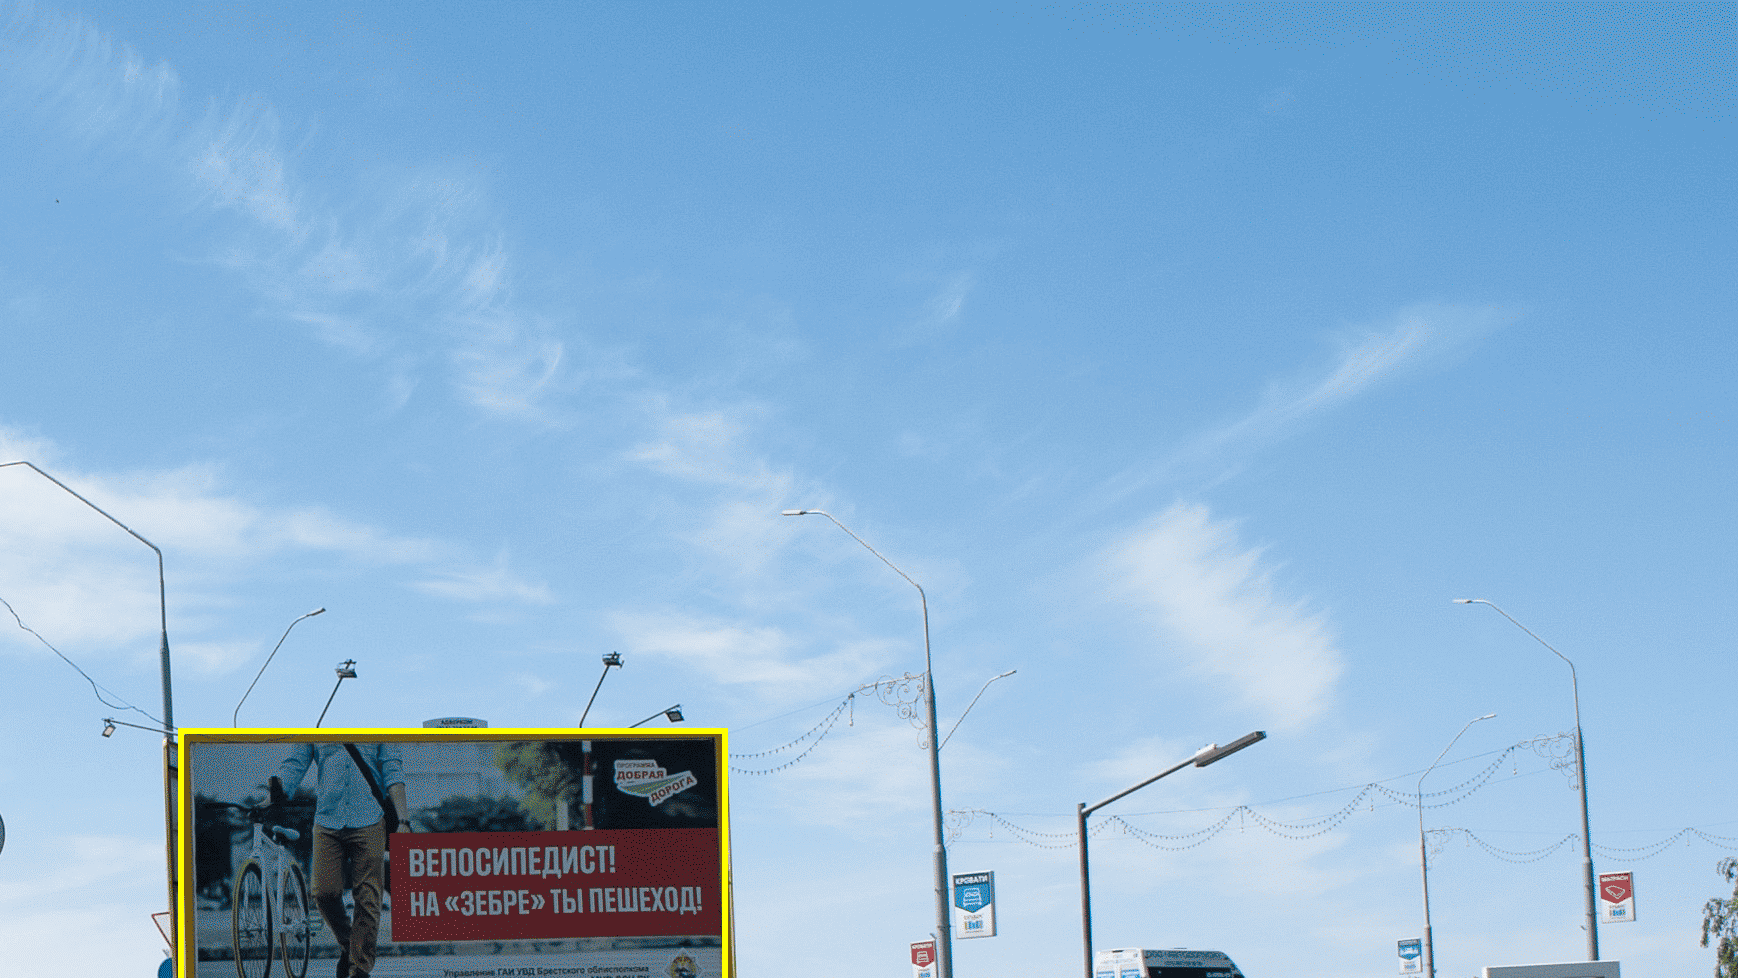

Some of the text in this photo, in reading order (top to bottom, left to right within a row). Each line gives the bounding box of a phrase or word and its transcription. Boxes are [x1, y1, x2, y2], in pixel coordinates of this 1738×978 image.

[616, 770, 664, 781] ДОБРАЯ
[651, 776, 694, 803] ДОРОГА
[409, 845, 616, 880] ВЕЛОСИПЕДИСТ!
[955, 875, 988, 885] КРОВАТИ
[410, 886, 703, 917] НА «ЗЕБРЕ» ТЫ ПЕШЕХОД!
[443, 965, 649, 978] Управление ГАИ УВД Брестского облисполкома
